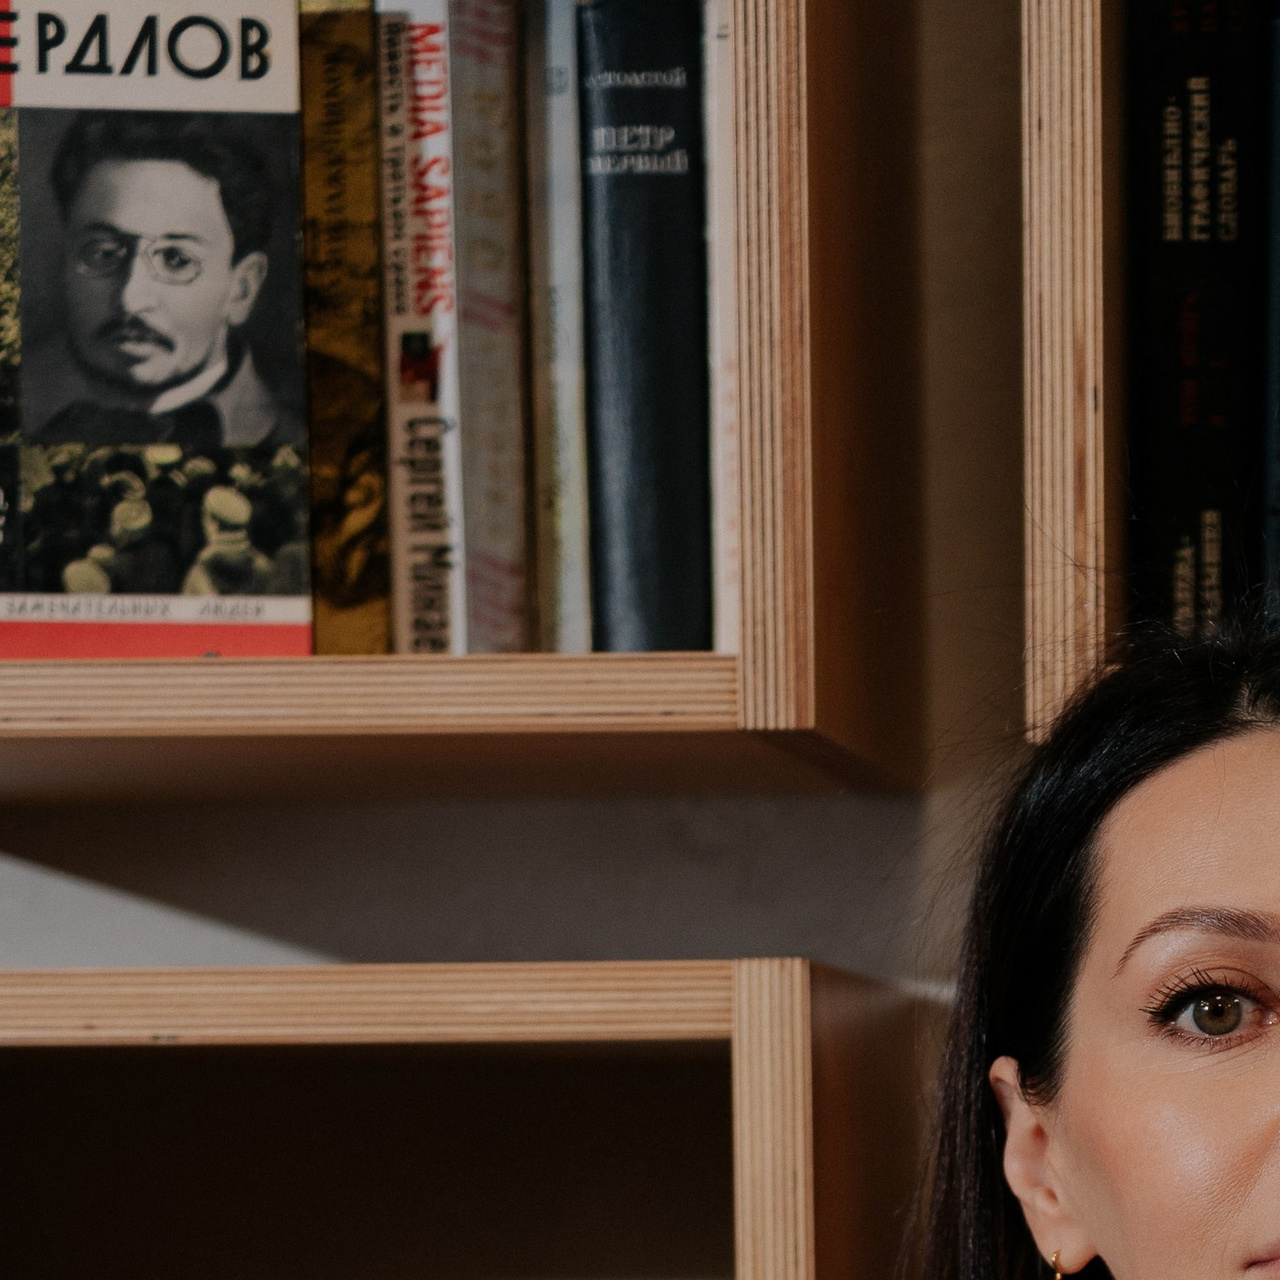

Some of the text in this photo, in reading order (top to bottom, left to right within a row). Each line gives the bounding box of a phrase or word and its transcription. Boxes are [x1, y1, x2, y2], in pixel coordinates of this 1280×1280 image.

[405, 23, 455, 317] MEDIA SAPIENS
[587, 149, 689, 175] ПЕРВЫЙ
[1187, 74, 1212, 242] ГРАФИЧЕСКИЙ
[1216, 136, 1239, 242] СЛОВАРЬ
[393, 417, 454, 651] Сергей Минае
